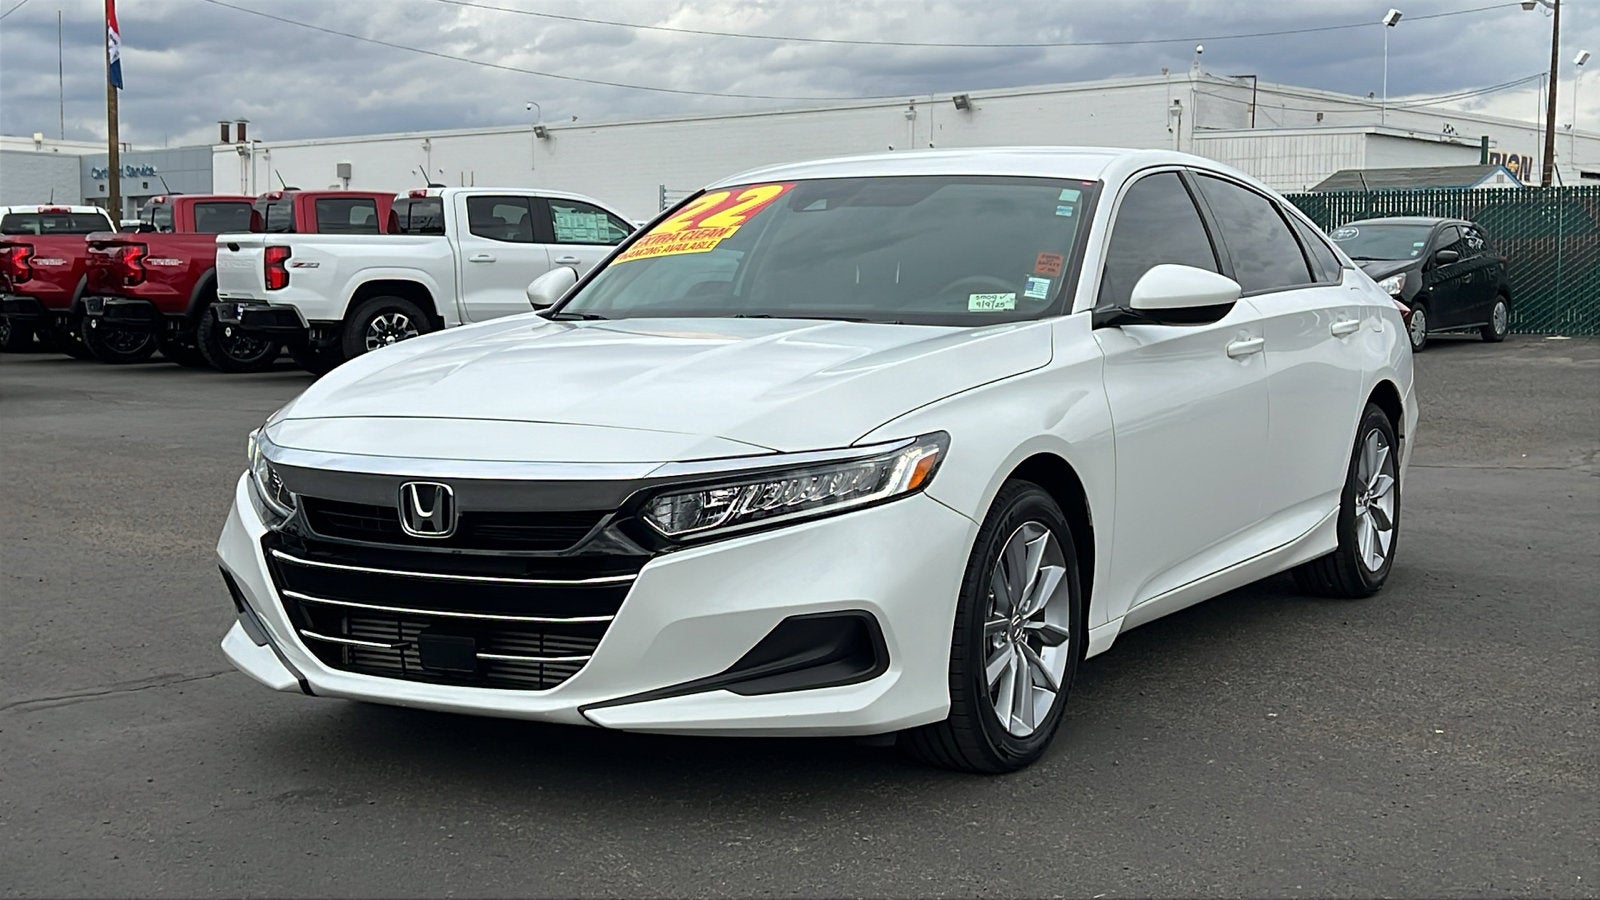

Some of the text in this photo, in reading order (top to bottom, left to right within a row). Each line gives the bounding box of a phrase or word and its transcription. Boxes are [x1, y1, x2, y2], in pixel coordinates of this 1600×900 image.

[91, 164, 157, 180] Certd Service
[647, 185, 784, 236] 22
[632, 226, 733, 249] EXTRA CLEAN
[663, 240, 718, 254] AVAILABLE
